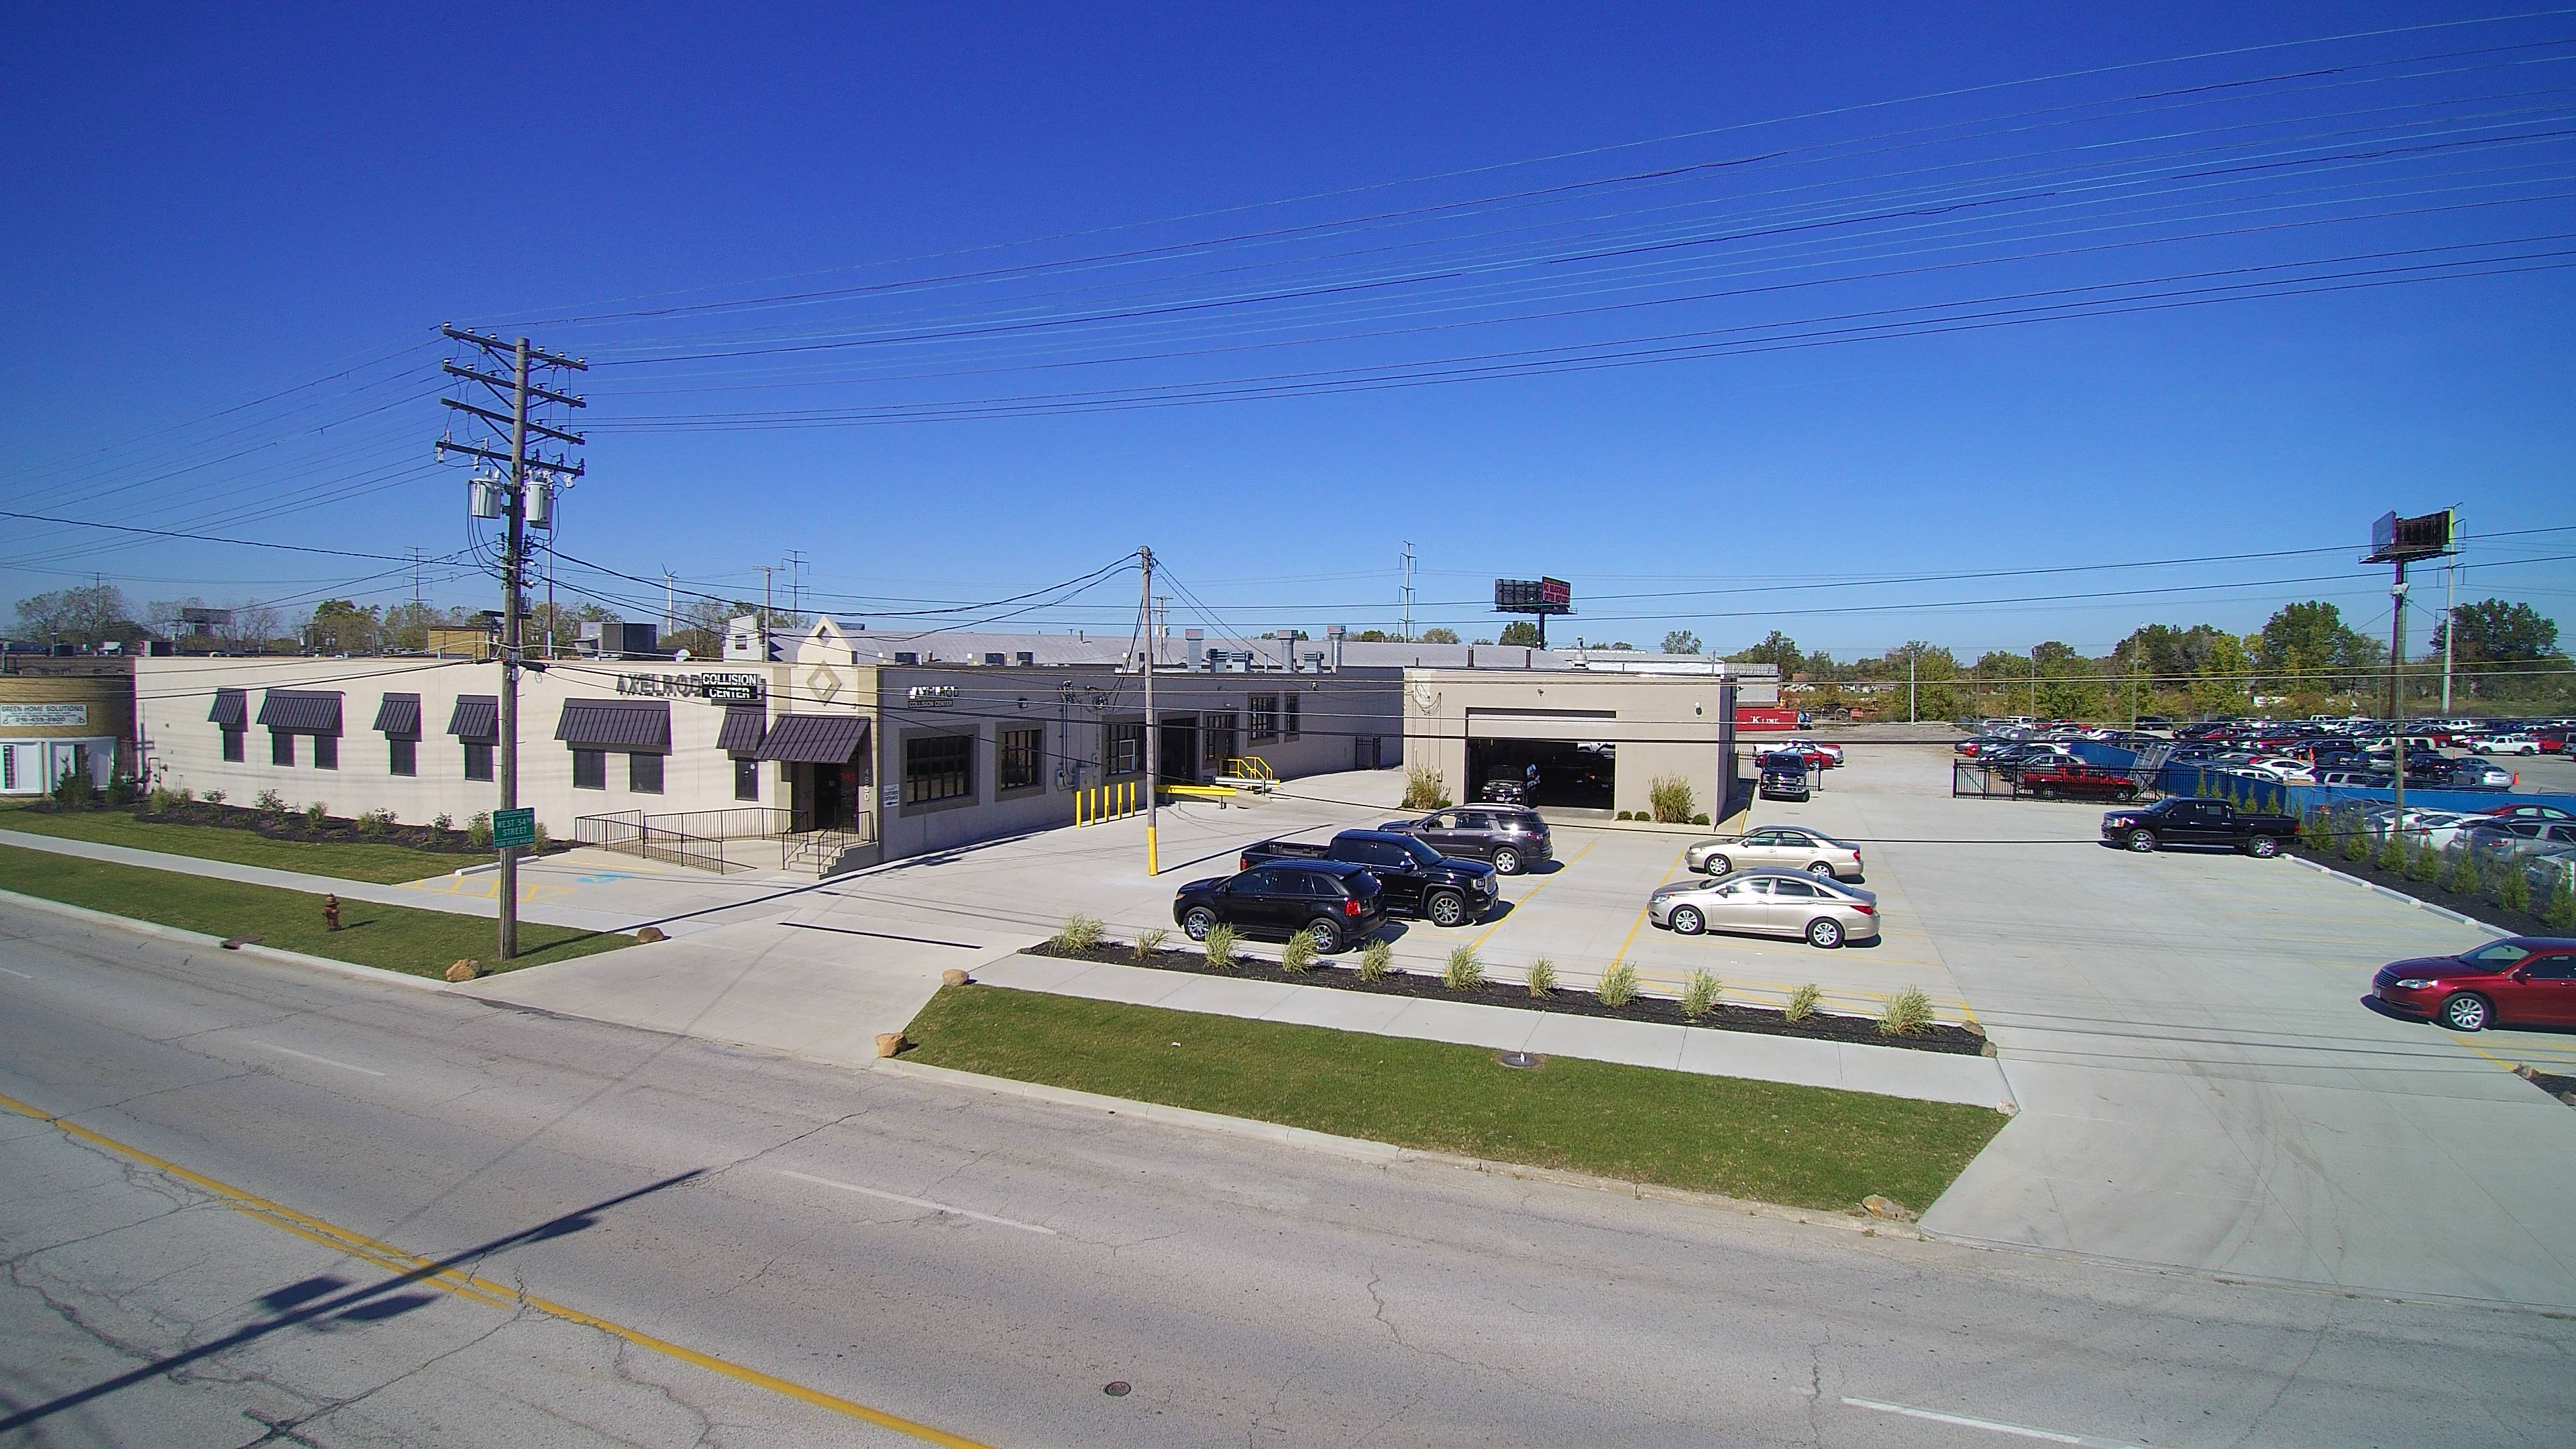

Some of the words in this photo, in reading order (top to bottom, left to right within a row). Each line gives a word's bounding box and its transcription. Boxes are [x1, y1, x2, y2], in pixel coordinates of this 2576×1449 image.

[702, 674, 757, 686] COLLISION
[709, 687, 750, 699] CENTER
[497, 819, 515, 828] WEST
[502, 826, 527, 837] STREET
